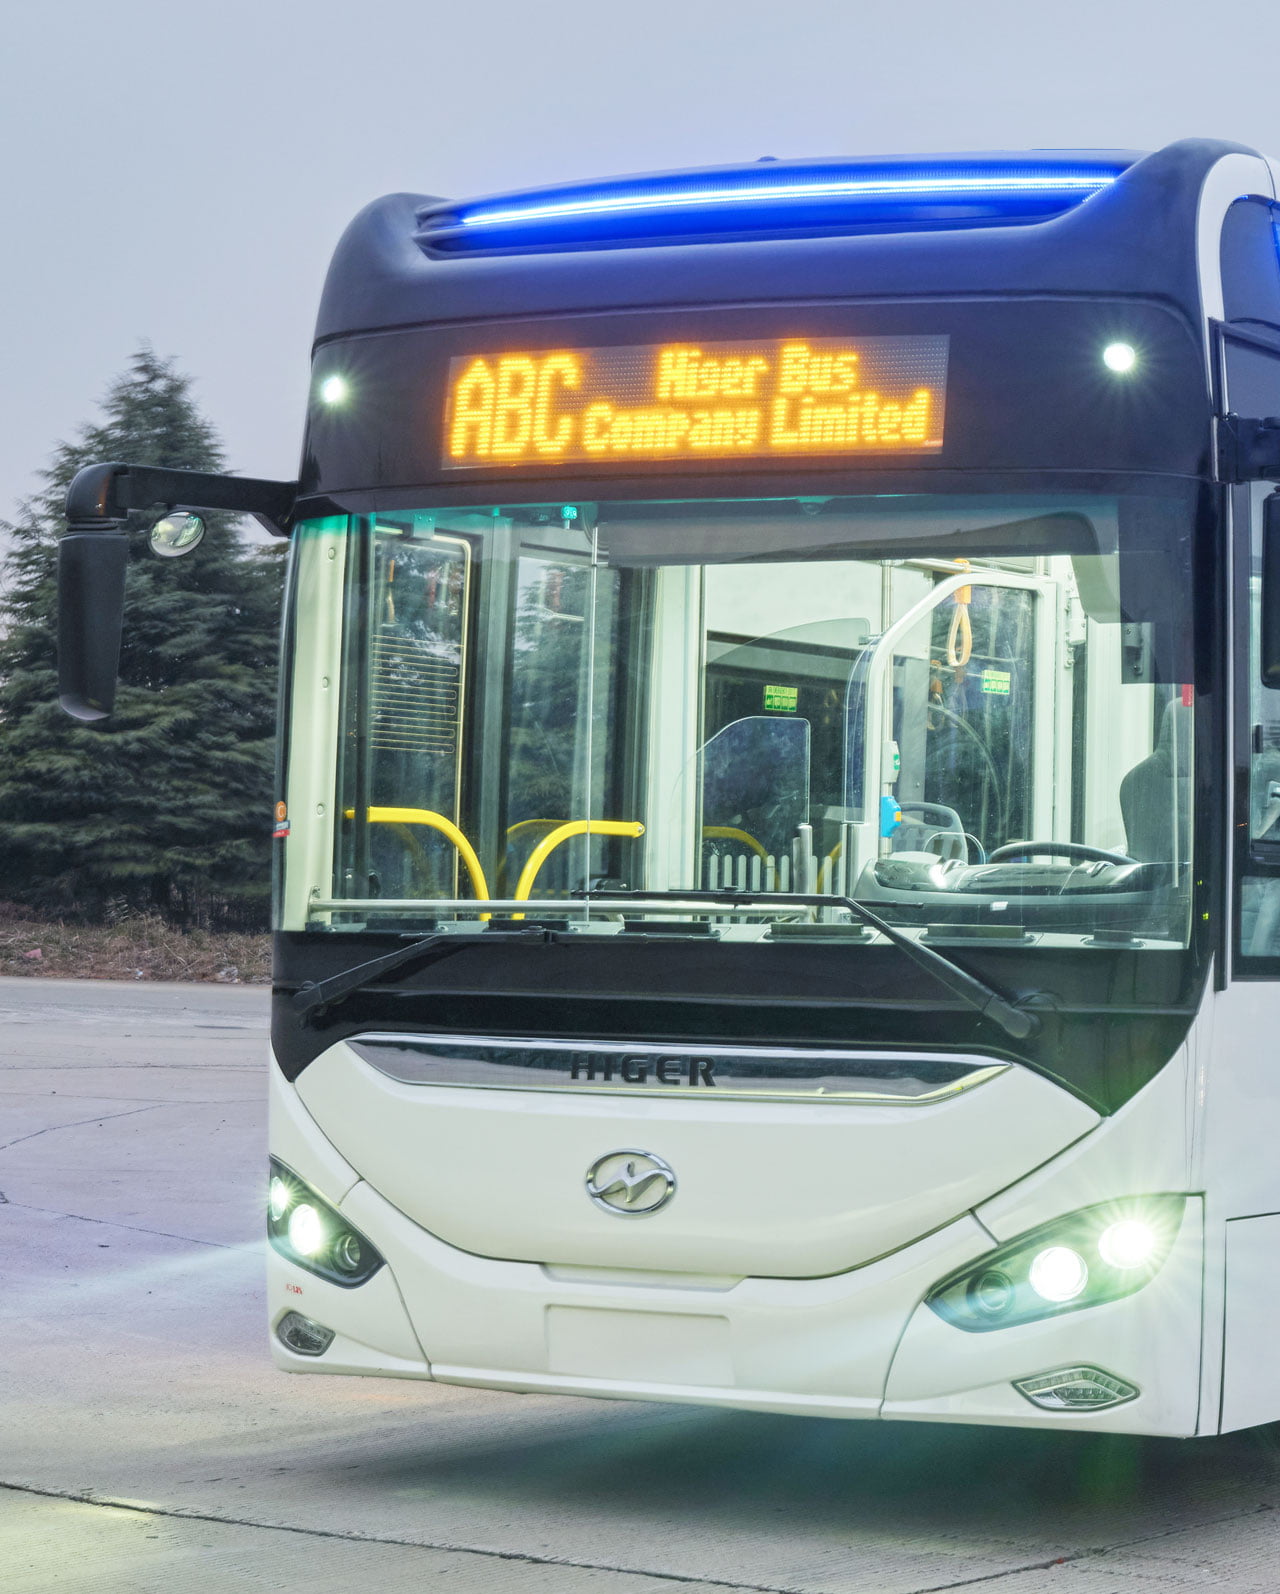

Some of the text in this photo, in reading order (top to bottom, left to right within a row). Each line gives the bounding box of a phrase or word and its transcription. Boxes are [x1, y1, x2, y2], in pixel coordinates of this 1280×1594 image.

[779, 345, 859, 393] Bus
[450, 353, 581, 458] ABC
[583, 389, 931, 452] Company Limited
[571, 1052, 717, 1087] HIGER
